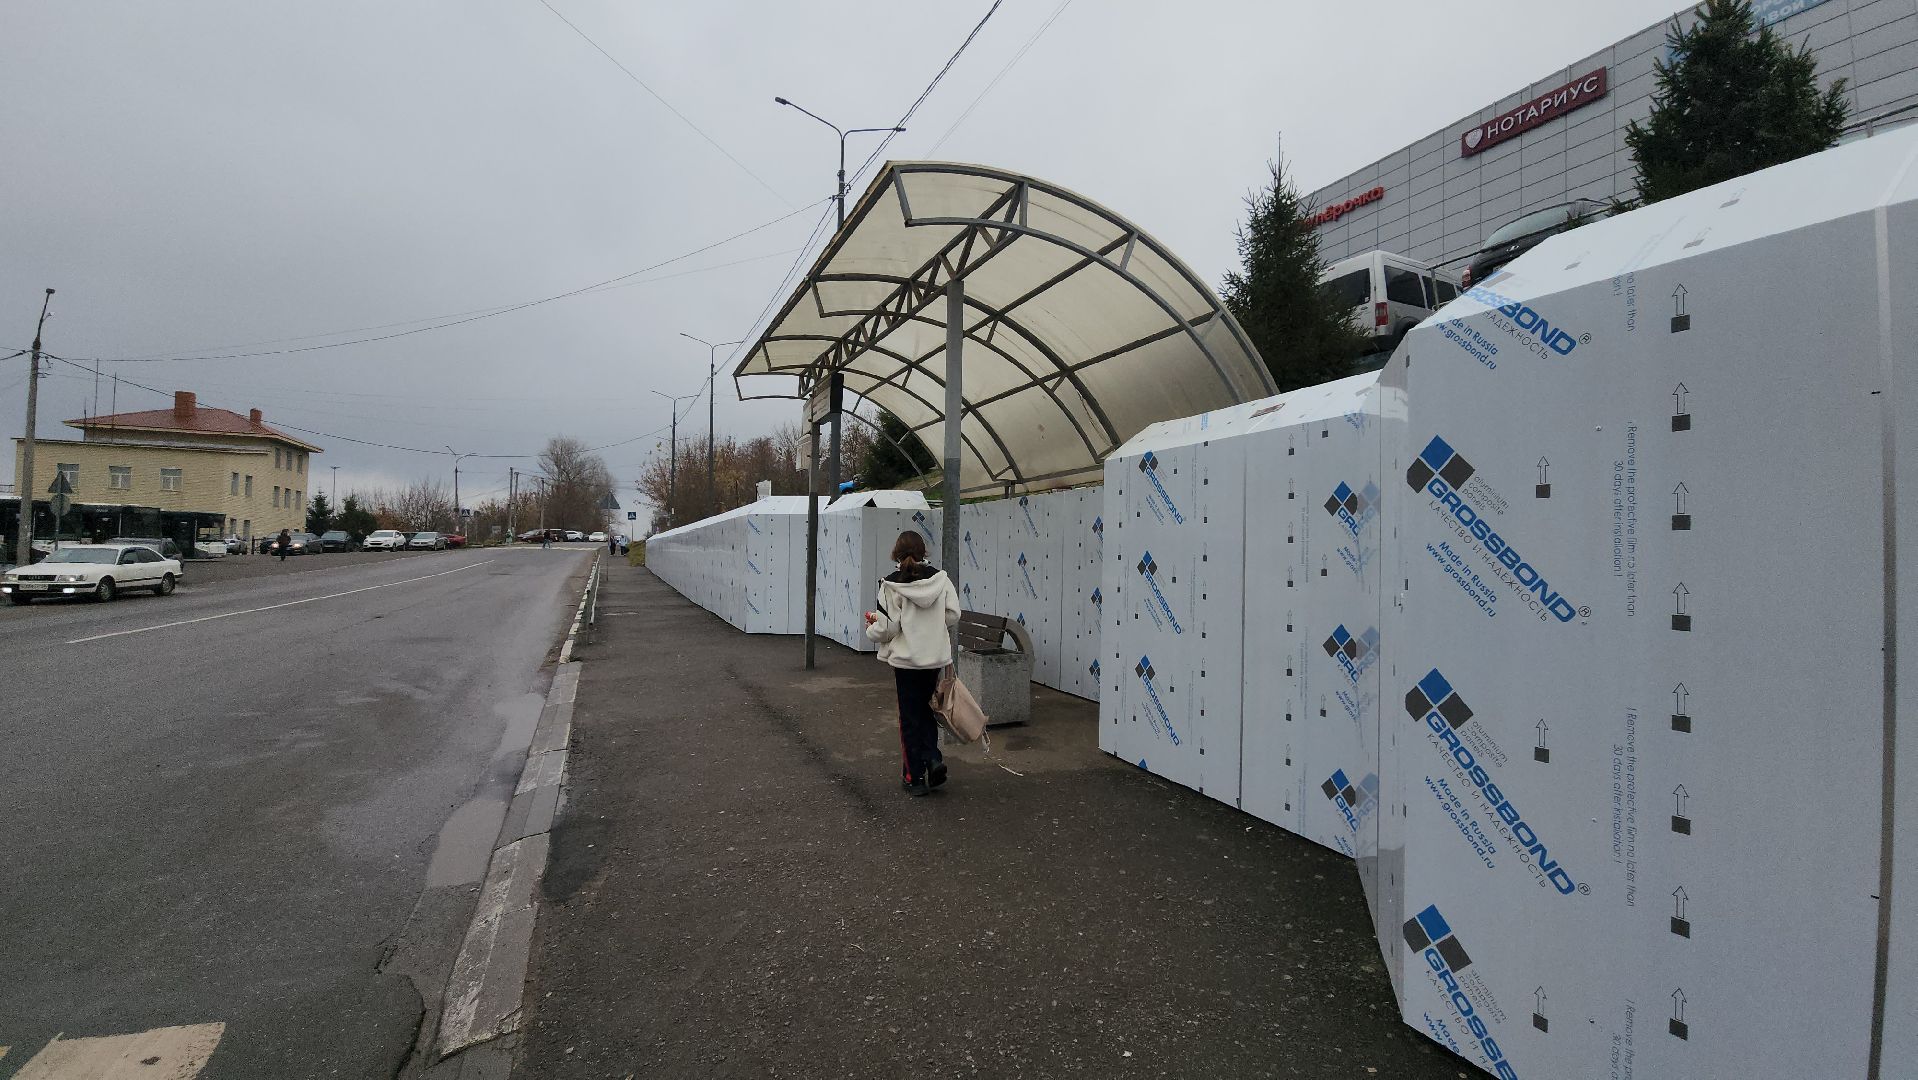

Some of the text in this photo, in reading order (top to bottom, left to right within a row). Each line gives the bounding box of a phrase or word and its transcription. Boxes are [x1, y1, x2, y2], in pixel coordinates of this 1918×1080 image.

[1487, 76, 1598, 138] НОТАРИУС
[1464, 324, 1473, 337] in
[1472, 331, 1498, 356] Russia
[1627, 426, 1637, 466] Remove
[1613, 461, 1623, 472] 30
[1627, 469, 1637, 484] the
[1613, 498, 1623, 520] after
[1625, 486, 1637, 535] protective
[1427, 477, 1577, 622] GROSSBOND
[1429, 500, 1548, 622] КАЧЕСТВО И НАДЕЖНОСТЬ
[1613, 522, 1623, 571] installation
[1626, 538, 1637, 553] film
[1426, 543, 1496, 618] www.grossbond.ru
[1439, 541, 1497, 603] Made in Russia
[1626, 595, 1637, 617] than
[1613, 743, 1623, 755] 30
[1626, 713, 1637, 753] Remove
[1611, 757, 1623, 780] days
[1626, 756, 1637, 771] the
[1425, 711, 1576, 895] GROSSBOND
[1427, 733, 1547, 888] КАЧЕСТВО И НАДЕЖНОСТЬ
[1613, 782, 1623, 805] after
[1625, 773, 1637, 822] protective
[1425, 775, 1496, 869] www.grossbond.ru
[1437, 778, 1496, 854] Made in Russia
[1626, 845, 1635, 857] no
[1626, 859, 1637, 882] later
[1626, 884, 1637, 907] than
[1426, 970, 1470, 1035] КАЧЕСТВО
[1437, 1019, 1460, 1054] Made
